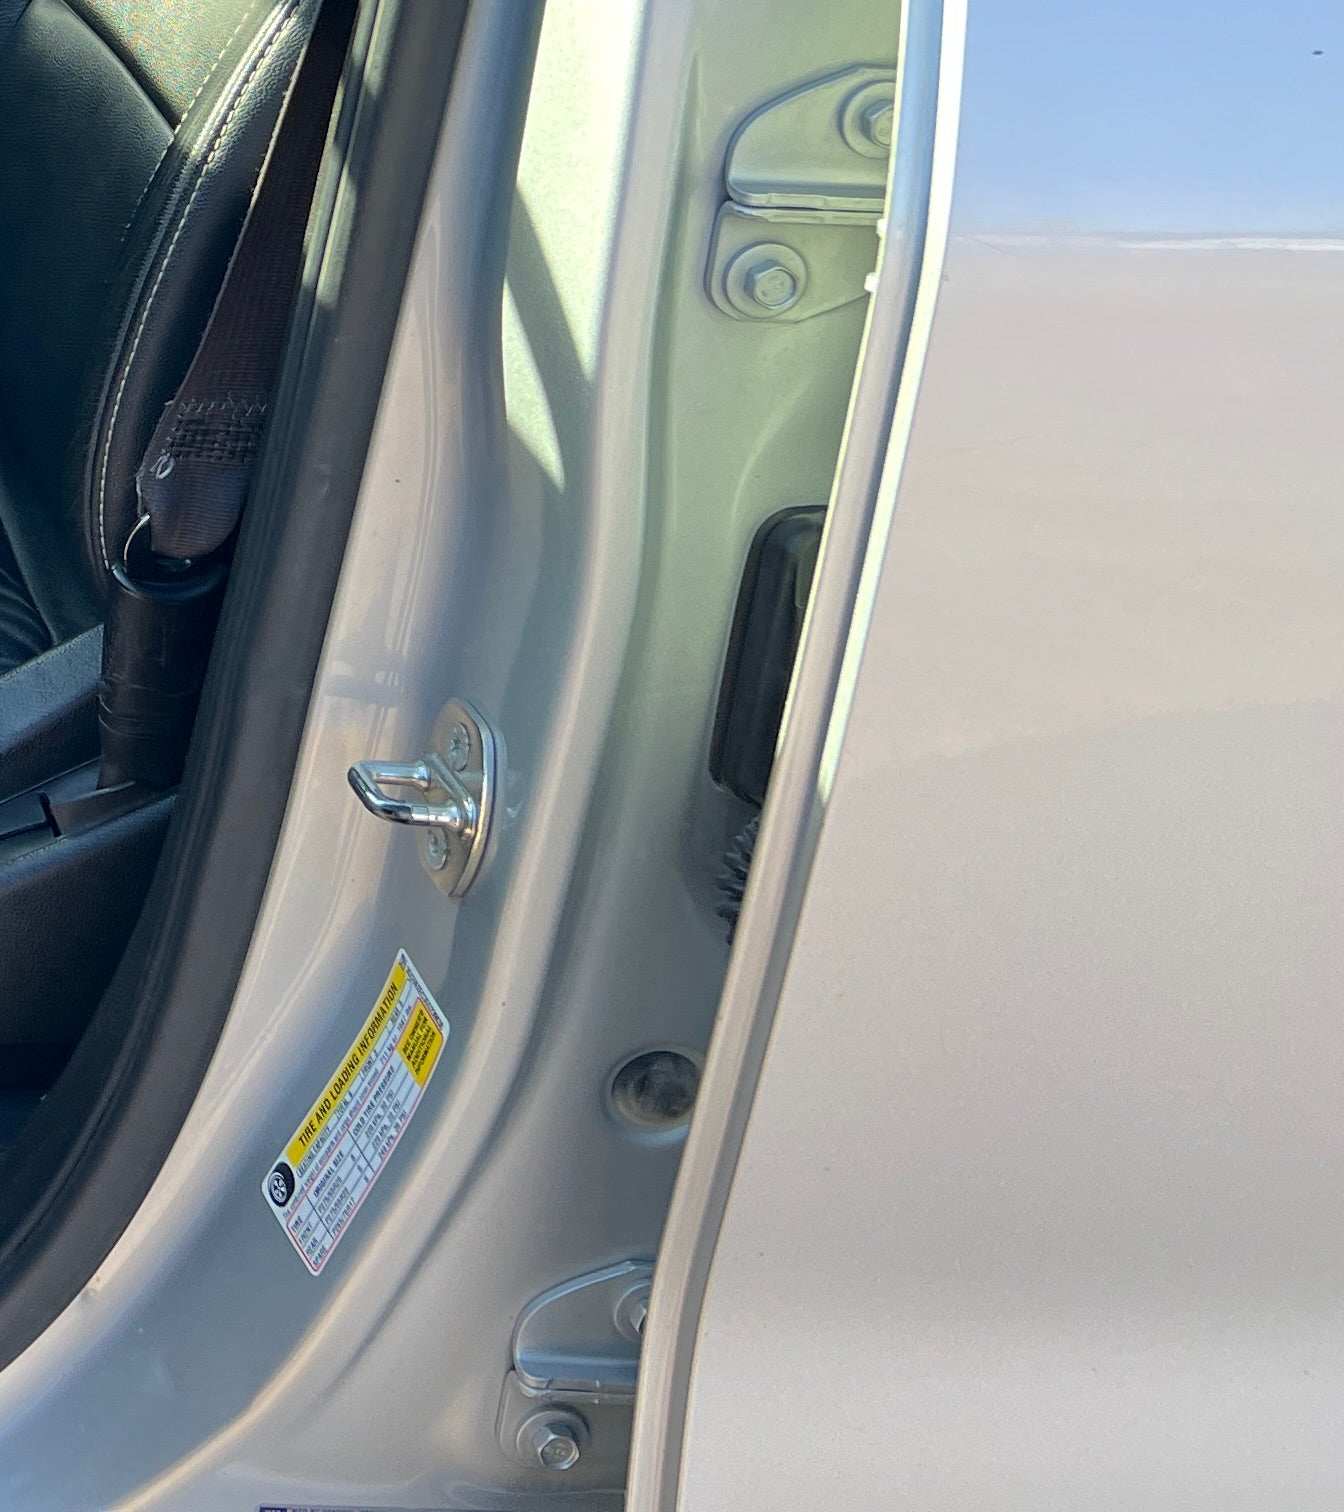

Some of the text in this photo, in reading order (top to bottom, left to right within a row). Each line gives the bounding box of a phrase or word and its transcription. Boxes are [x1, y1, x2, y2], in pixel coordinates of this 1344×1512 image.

[291, 1214, 302, 1234] TIRE
[313, 1164, 334, 1199] ORIGINAL
[332, 1149, 344, 1168] SIZE
[352, 1115, 365, 1137] COLD
[363, 1099, 374, 1119] TIRE
[372, 1064, 394, 1102] PRESSURE
[298, 1119, 316, 1149] TIRE
[313, 1096, 332, 1125] AND
[329, 1051, 359, 1101] LOADING
[357, 981, 397, 1056] INFORMATION
